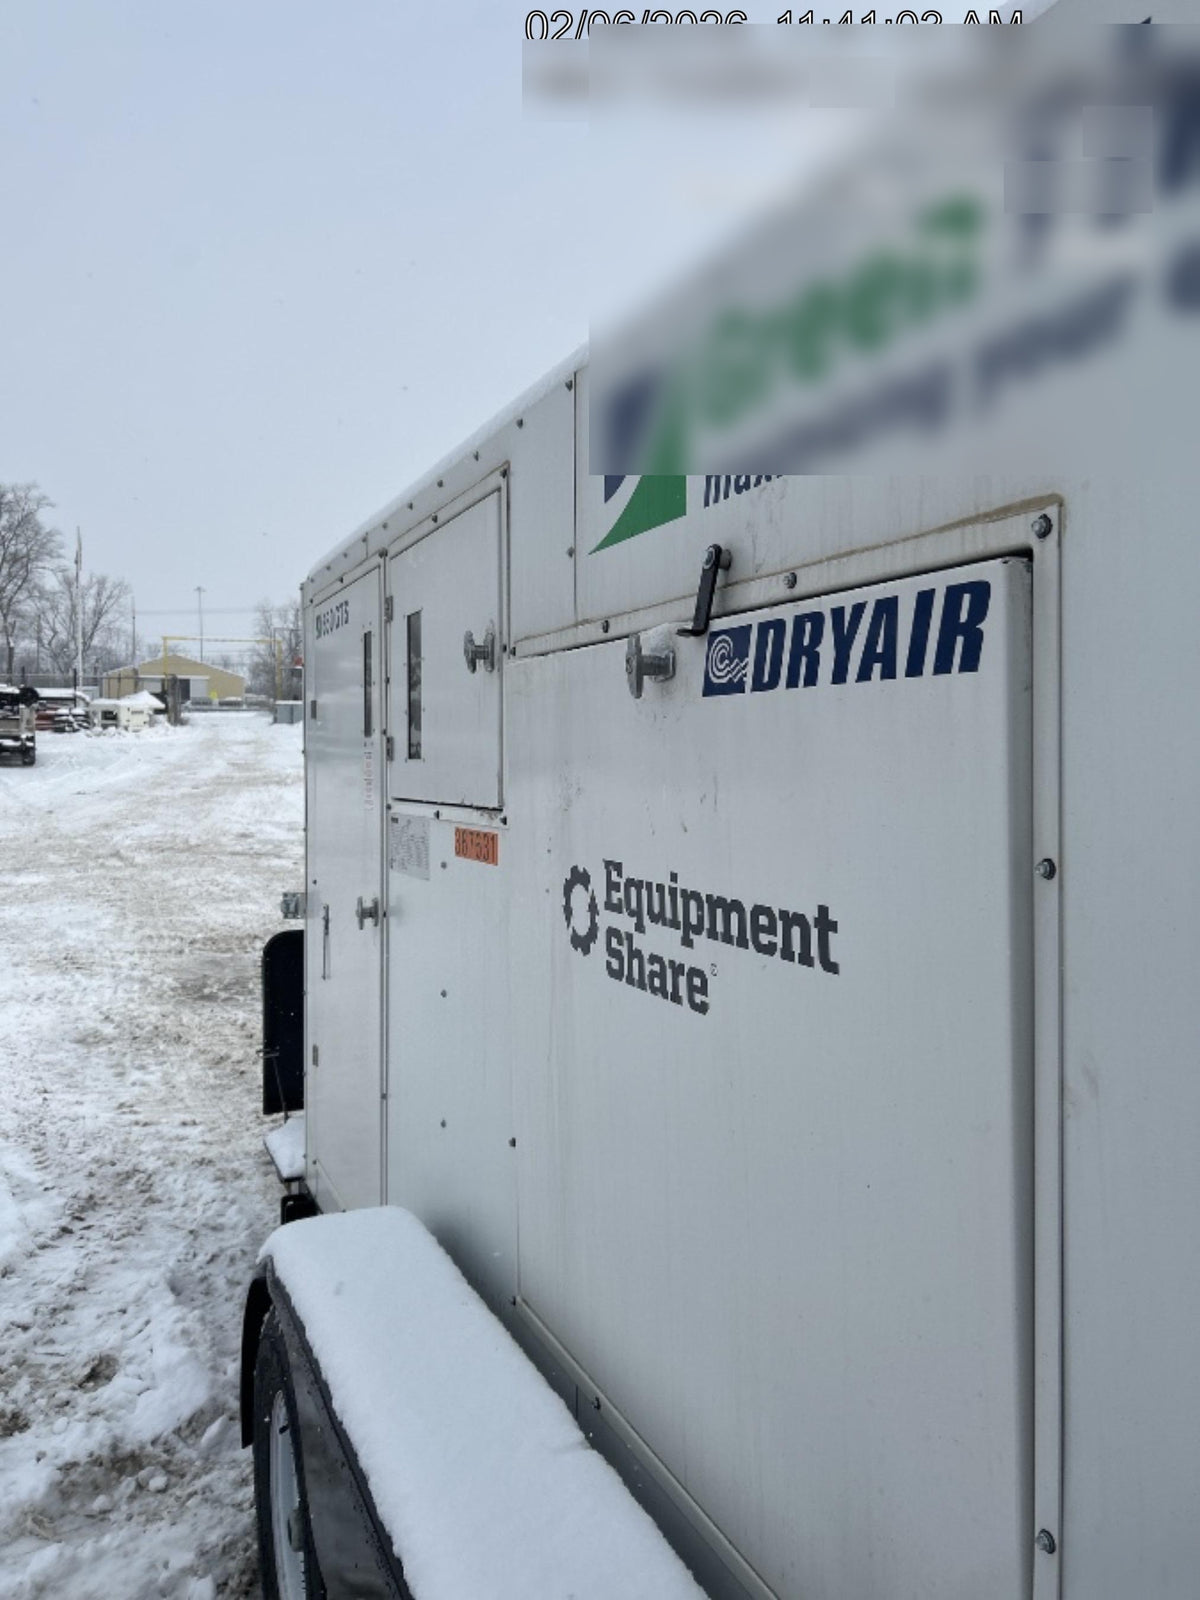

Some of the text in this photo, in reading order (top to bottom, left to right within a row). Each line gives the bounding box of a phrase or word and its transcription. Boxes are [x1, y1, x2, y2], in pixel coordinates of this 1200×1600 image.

[751, 580, 991, 693] DRYAIR
[603, 858, 840, 976] Equipment
[605, 926, 710, 1016] Share
